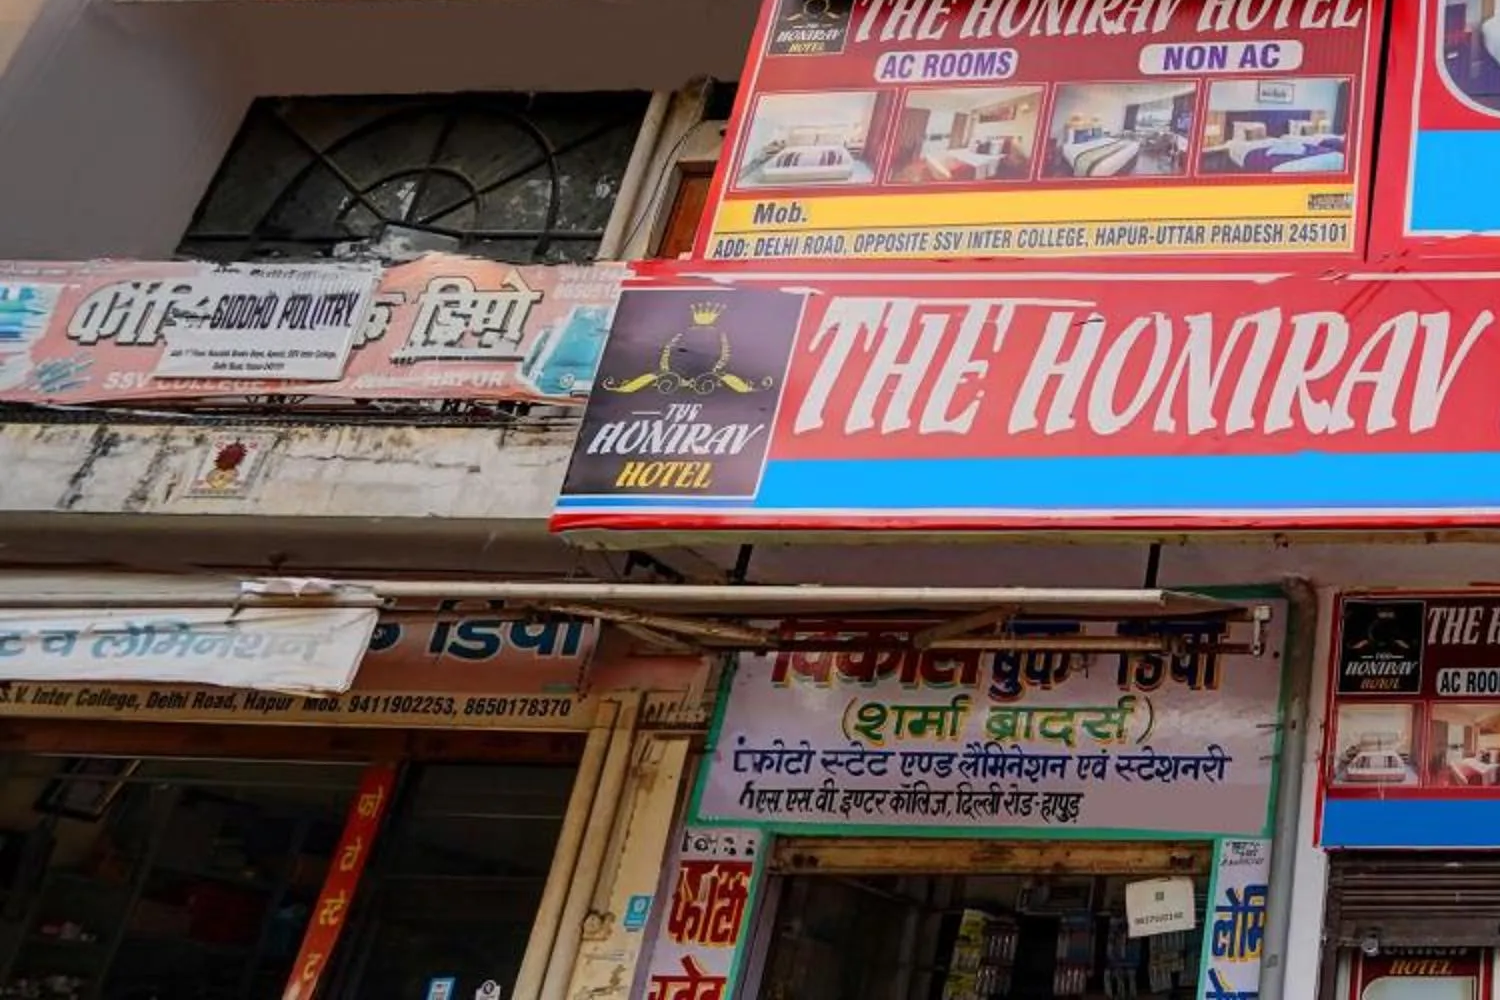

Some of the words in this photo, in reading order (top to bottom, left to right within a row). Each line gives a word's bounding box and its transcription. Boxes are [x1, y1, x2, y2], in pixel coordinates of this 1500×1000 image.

[880, 54, 919, 80] AC
[921, 50, 1014, 78] ROOMS
[1162, 46, 1229, 71] NON
[1236, 43, 1281, 70] AC
[752, 202, 808, 225] Mob.
[712, 238, 749, 259] ADD:
[753, 235, 799, 258] DELHI
[802, 233, 848, 257] ROAD,
[853, 231, 929, 254] OPPOSITE
[934, 230, 964, 252] SSV
[967, 228, 1012, 250] INTER
[1017, 227, 1090, 249] COLLEGE,
[1211, 222, 1285, 244] PRADESH
[1288, 221, 1348, 243] 245101
[793, 298, 1013, 434] THE
[1006, 307, 1495, 434] HONIRAV
[586, 420, 765, 456] HONIRAV
[615, 460, 716, 489] HOTEL
[1427, 605, 1484, 646] THE
[1439, 671, 1463, 694] AC
[31, 686, 72, 707] Inter
[242, 693, 294, 714] Hapur
[820, 740, 896, 778] स्टेट
[899, 750, 960, 778] एण्ड
[1076, 748, 1113, 781] एवं
[1114, 743, 1233, 784] स्टेशनरी
[1388, 958, 1454, 975] HOTEL
